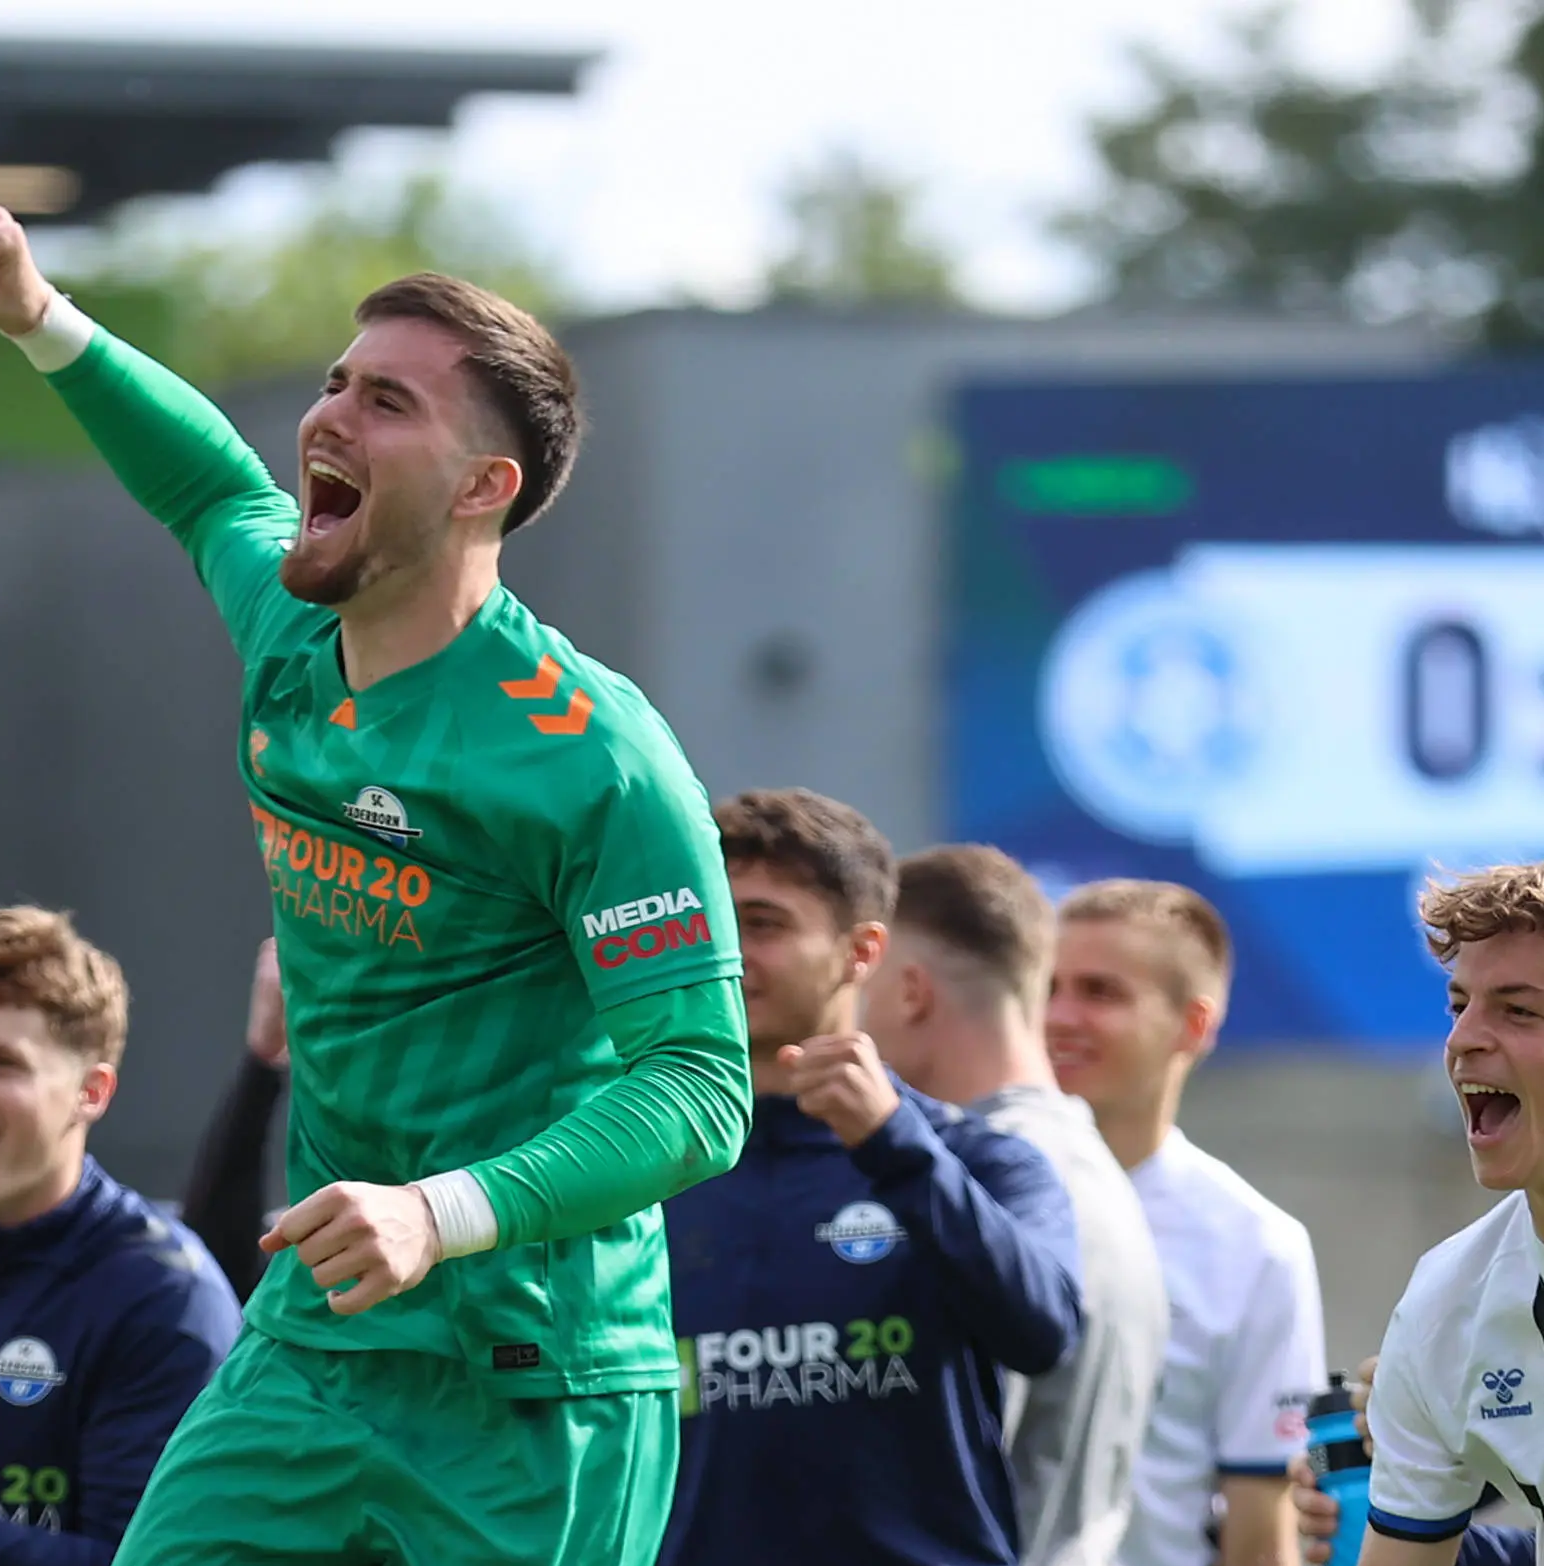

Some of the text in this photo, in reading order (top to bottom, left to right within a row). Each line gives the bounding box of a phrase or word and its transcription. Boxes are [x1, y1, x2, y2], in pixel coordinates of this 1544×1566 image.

[272, 818, 432, 908] FOUR 20
[269, 864, 424, 953] PHARMA
[582, 887, 704, 940] MEDIA
[592, 913, 712, 970] COM
[695, 1315, 914, 1372] FOUR 20
[698, 1353, 920, 1412] PHARMA
[1480, 1401, 1534, 1420] hummel
[0, 1463, 68, 1505] 20
